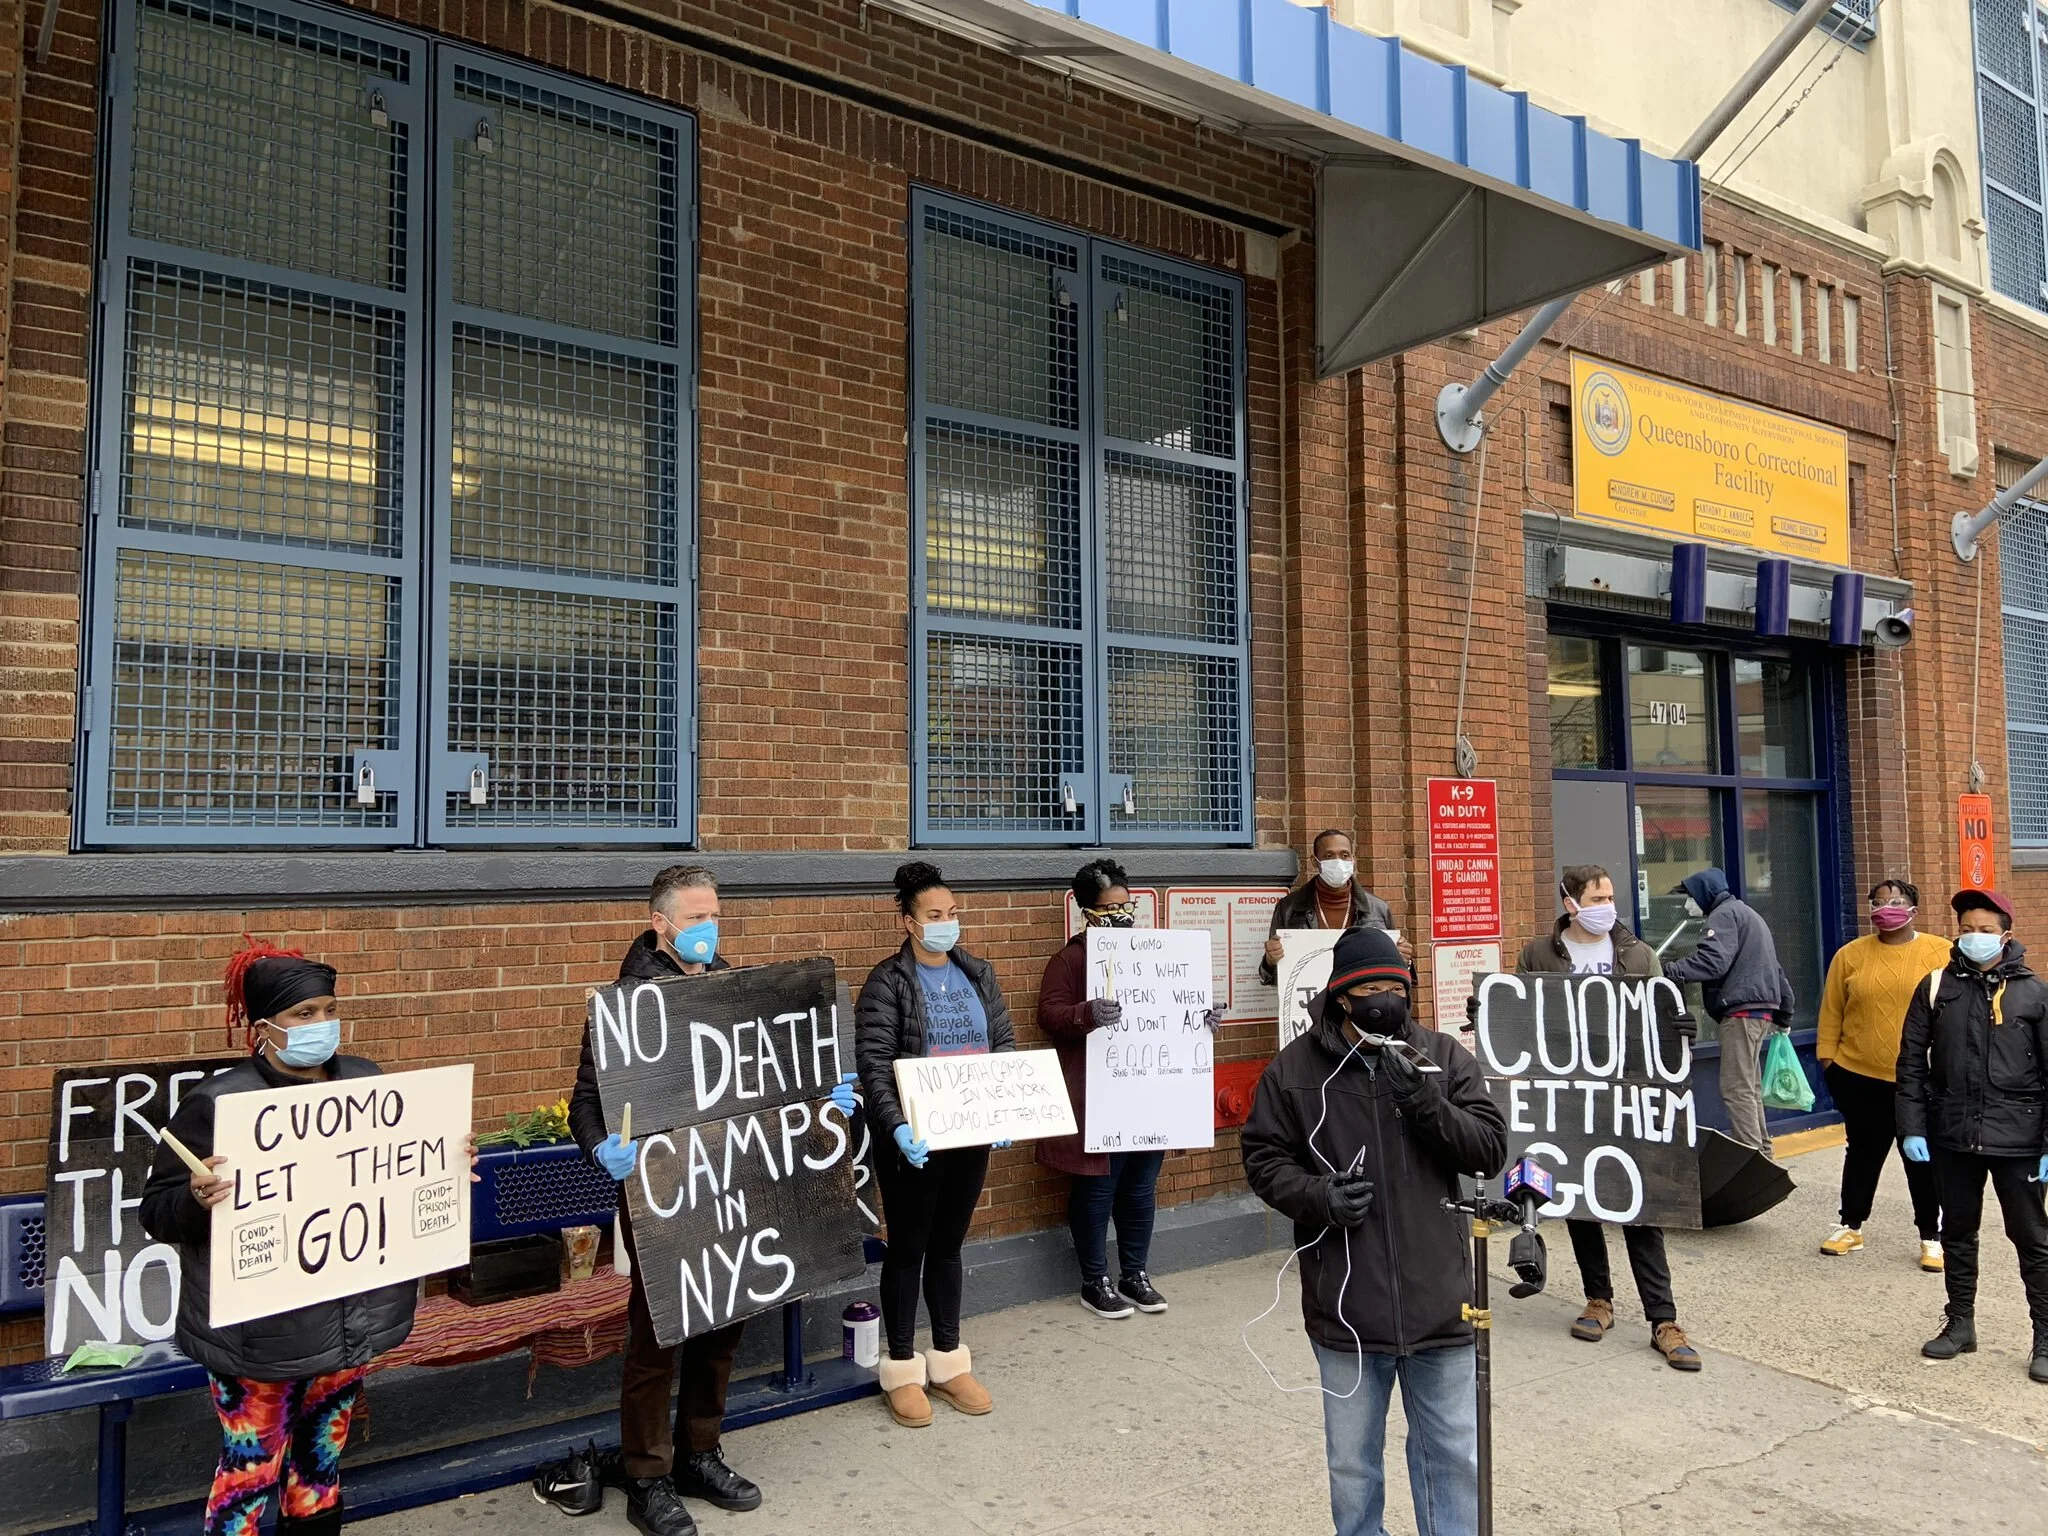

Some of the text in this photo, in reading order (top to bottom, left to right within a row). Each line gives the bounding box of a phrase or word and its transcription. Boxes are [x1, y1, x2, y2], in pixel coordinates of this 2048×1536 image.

[1665, 391, 1682, 403] NEW
[1683, 395, 1702, 410] YORK
[1638, 414, 1740, 462] Queensboro
[1745, 442, 1838, 487] Correctional
[1613, 483, 1639, 499] ANDREW
[1650, 491, 1672, 505] CUOMO
[1714, 462, 1775, 504] Facility
[1614, 501, 1648, 519] Governor
[1699, 503, 1722, 517] ANTHONY
[1698, 523, 1752, 540] ACTING COMMISSIONER
[1451, 785, 1474, 801] K-9
[1439, 805, 1487, 818] ON DUTY
[1965, 818, 1987, 840] NO
[1436, 858, 1494, 871] UNIDAD CANINA
[1442, 871, 1488, 884] DE GUARDIA
[1180, 896, 1217, 905] NOTICE
[1455, 949, 1483, 959] NOTICE
[1133, 961, 1142, 976] IS
[1155, 963, 1189, 980] WHAT
[1094, 986, 1206, 1006] HPPENS WHEN
[1182, 1009, 1211, 1035] ACT
[1477, 972, 1691, 1083] CUOMO
[594, 983, 842, 1112] NO DEATH
[927, 1030, 985, 1046] Michelle.
[916, 1059, 1035, 1094] NO DEATH CAMPS
[959, 1083, 1051, 1106] IN NEW YORK
[987, 1110, 1009, 1126] LET
[1011, 1107, 1040, 1125] THEM
[1040, 1103, 1066, 1121] GO!
[1485, 1079, 1570, 1133] ET
[254, 1089, 404, 1152] CUOMO
[638, 1098, 847, 1218] CAMPS
[234, 1136, 445, 1211] LET THEM
[1524, 1141, 1643, 1223] GO
[714, 1188, 748, 1234] IN
[420, 1213, 449, 1232] DEATH
[297, 1196, 386, 1275] GO!
[239, 1250, 272, 1270] DEATH
[680, 1227, 796, 1338] NYS
